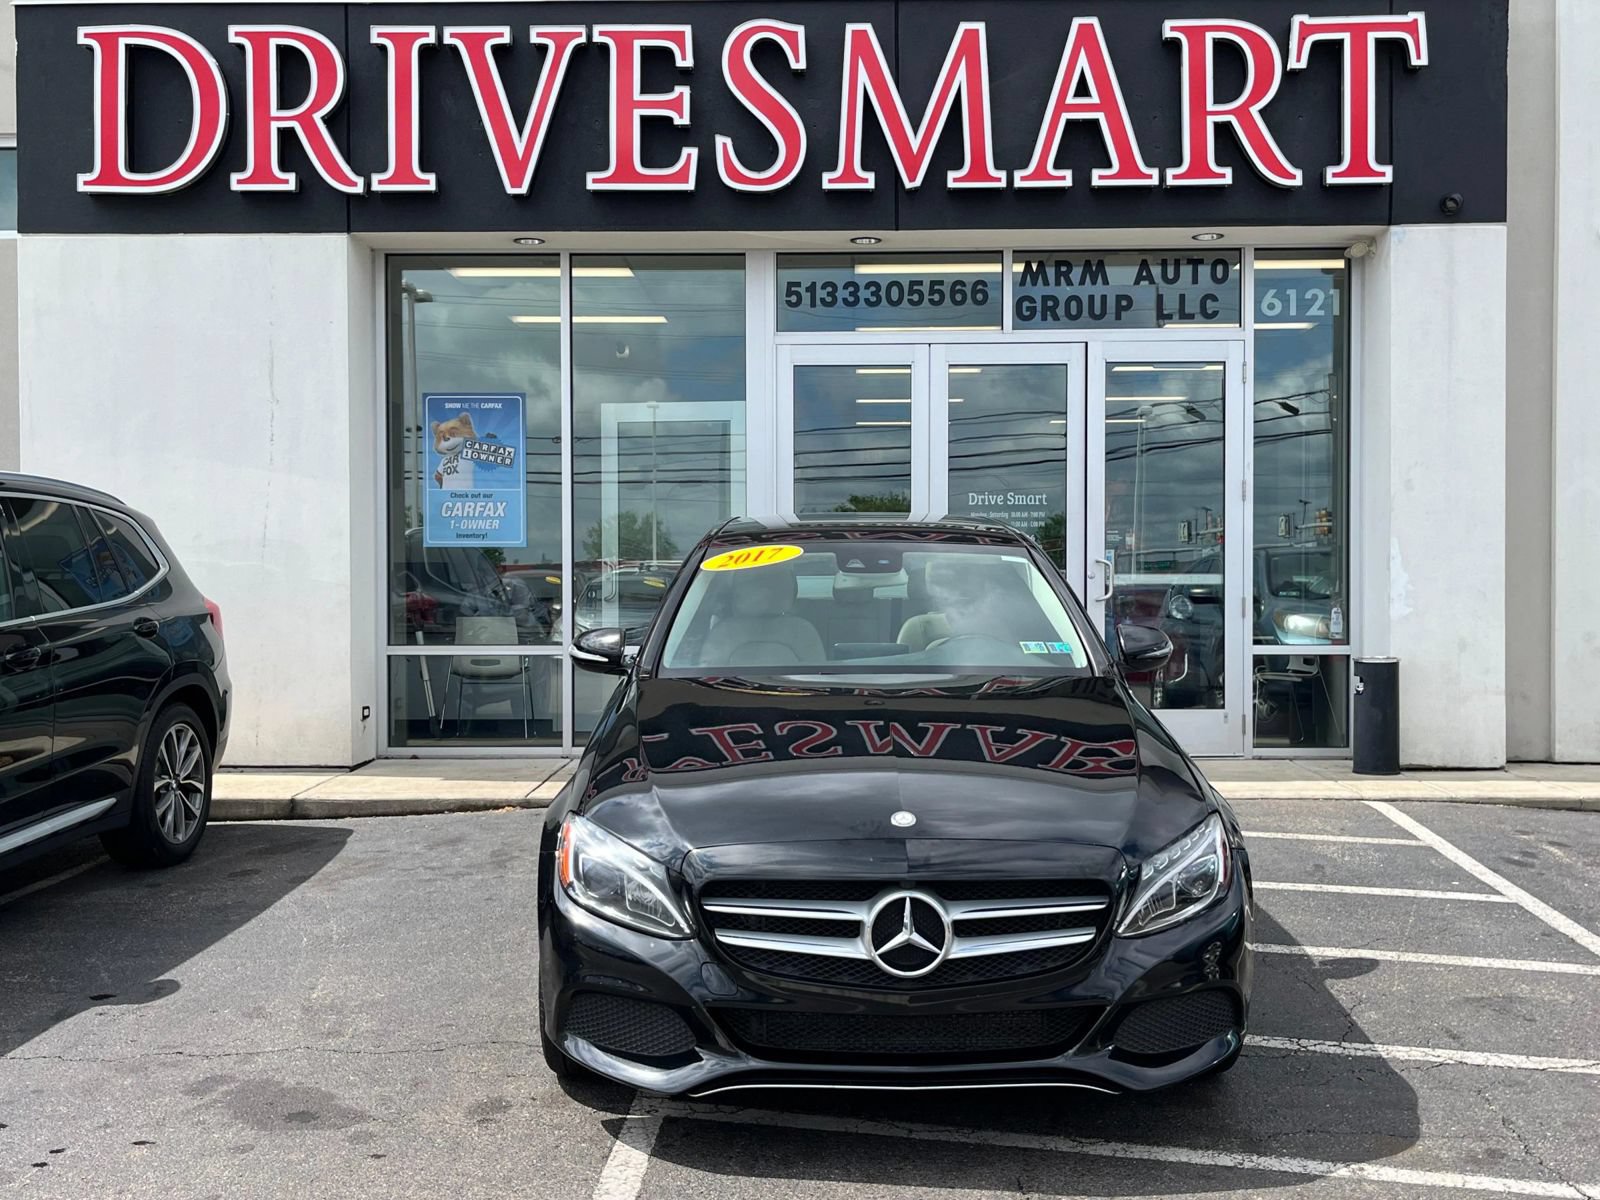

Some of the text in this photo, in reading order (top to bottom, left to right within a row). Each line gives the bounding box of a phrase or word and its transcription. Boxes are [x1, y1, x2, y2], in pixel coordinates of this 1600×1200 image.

[76, 11, 1428, 195] DRIVESMART
[1019, 258, 1230, 286] MRM AUTO
[784, 279, 989, 308] 5133305566
[1260, 287, 1341, 317] 6121
[1016, 293, 1220, 321] GROUP LLC
[465, 440, 514, 457] CARFAX
[450, 491, 469, 499] Check
[968, 491, 1048, 505] Drive Smart
[441, 501, 507, 517] CARFAX
[456, 532, 488, 540] Inventory!
[716, 547, 785, 569] 2017
